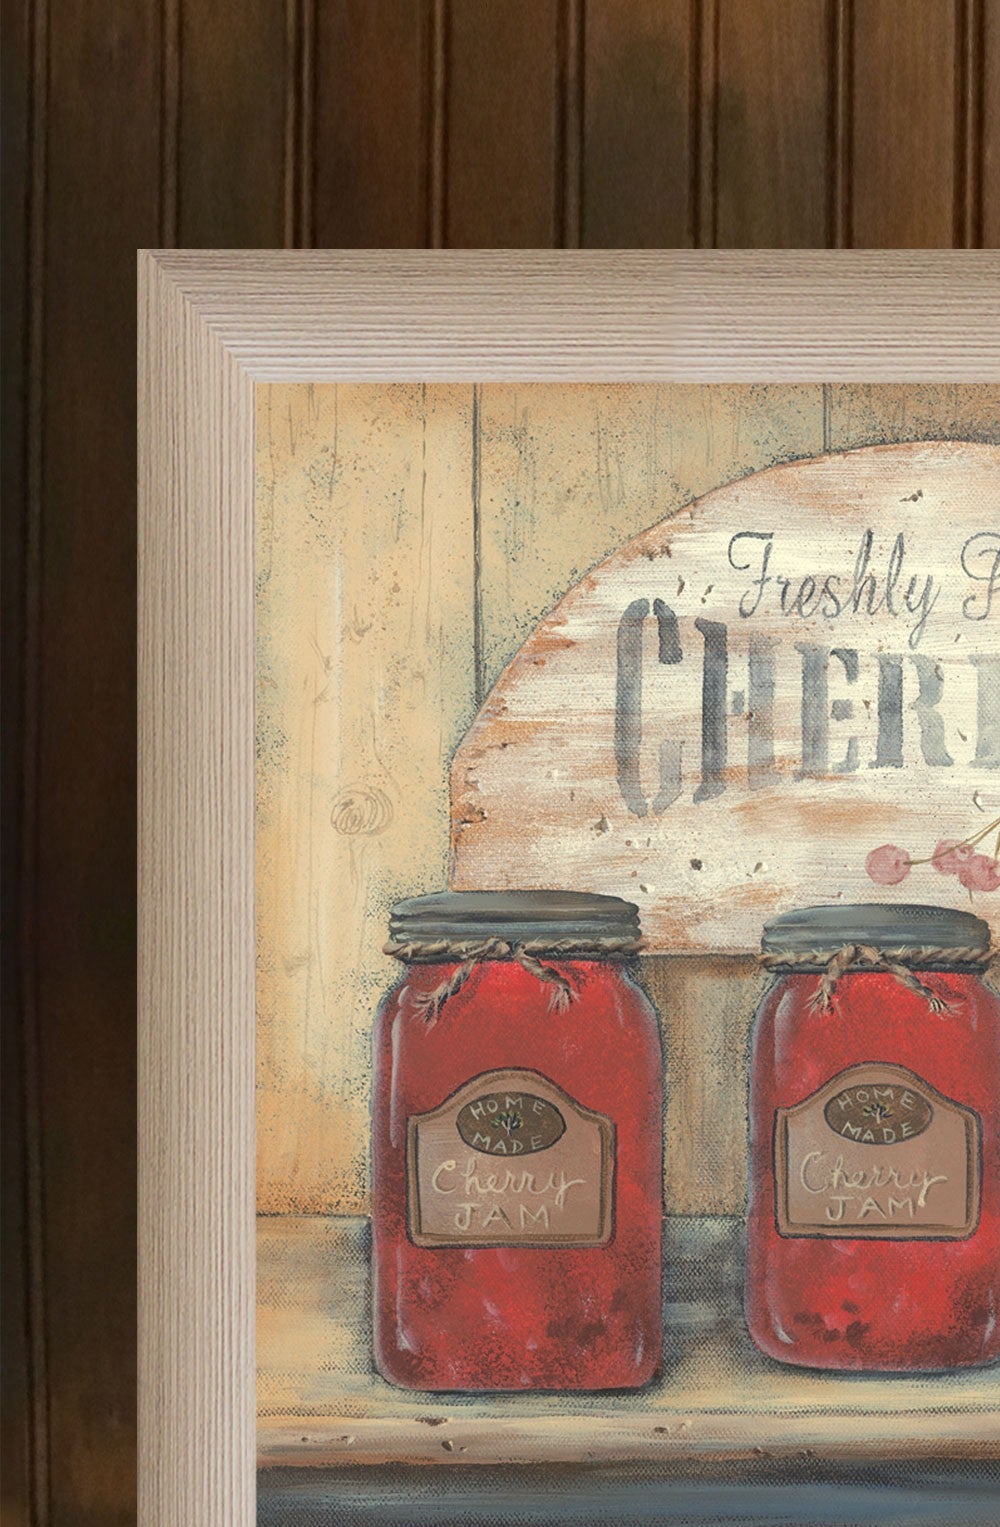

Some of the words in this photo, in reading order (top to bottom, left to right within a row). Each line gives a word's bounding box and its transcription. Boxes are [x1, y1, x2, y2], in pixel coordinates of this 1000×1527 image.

[727, 529, 941, 647] Freshly
[470, 1095, 546, 1120] HOME
[837, 1086, 916, 1111] HOME
[471, 1131, 545, 1154] MADE
[841, 1121, 915, 1144] MADE
[431, 1153, 586, 1211] Cherry
[800, 1150, 948, 1207] Cherry
[453, 1202, 550, 1230] JAM
[826, 1195, 915, 1221] JAM
